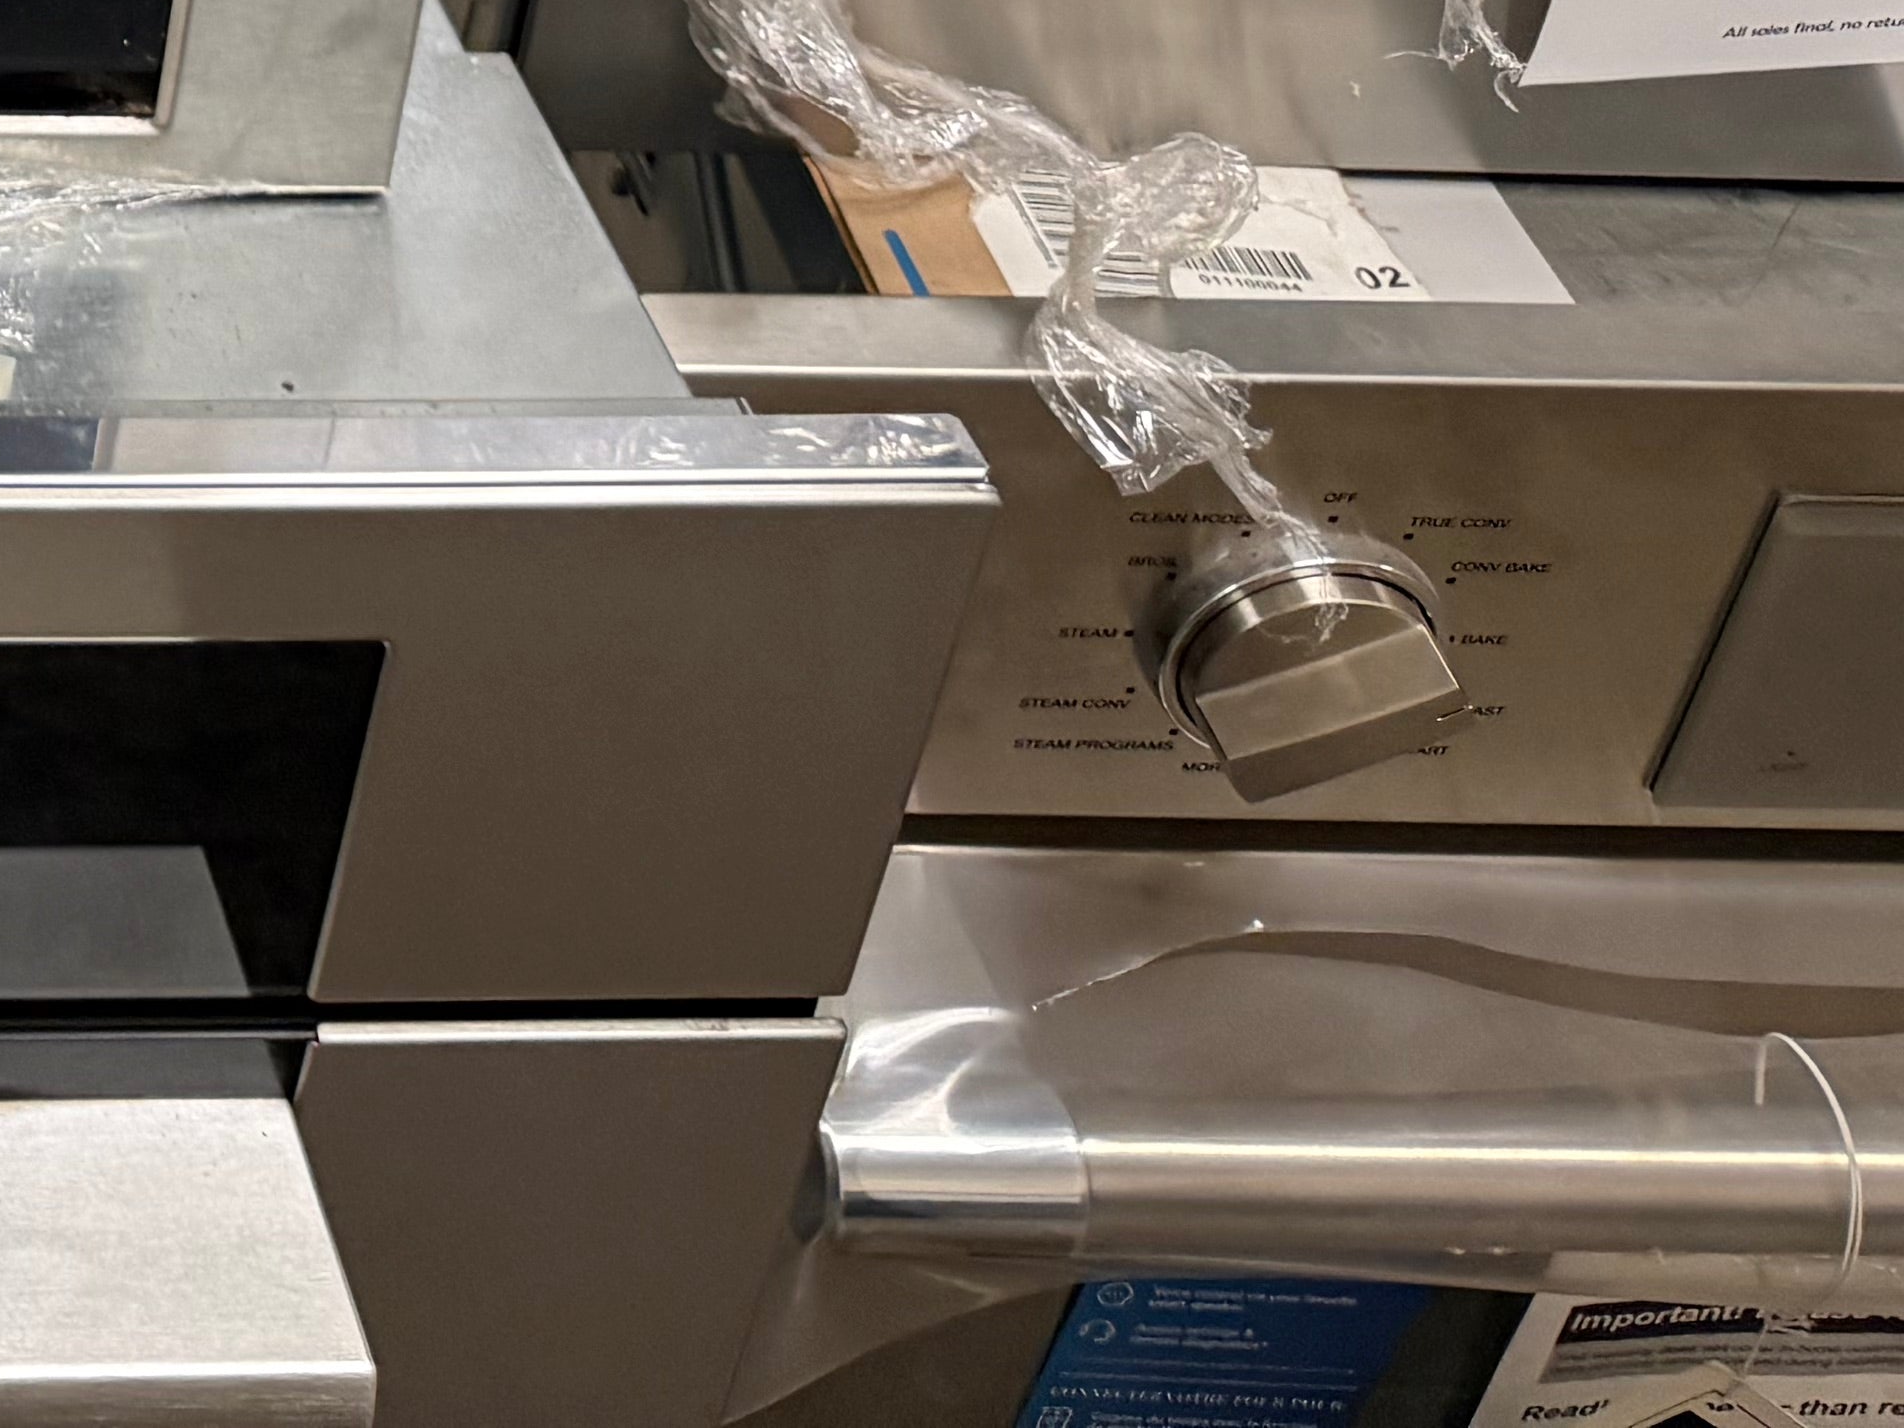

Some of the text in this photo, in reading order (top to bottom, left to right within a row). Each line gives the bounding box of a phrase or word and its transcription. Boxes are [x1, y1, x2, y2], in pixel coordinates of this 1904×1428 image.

[1722, 26, 1747, 38] All
[1751, 24, 1789, 37] sales
[1840, 20, 1863, 31] no
[1354, 266, 1412, 290] 02
[1324, 492, 1358, 503] OFF
[1129, 511, 1189, 523] CLEAN
[1410, 516, 1512, 528] TRUE CONV
[1451, 561, 1552, 573] CONV BAKE
[1058, 628, 1118, 639] STEAM
[1019, 698, 1132, 709] STEAM CONV
[1014, 739, 1175, 751] STEAM PROGRAMS
[1182, 762, 1221, 773] MOR
[1799, 1399, 1868, 1416] than
